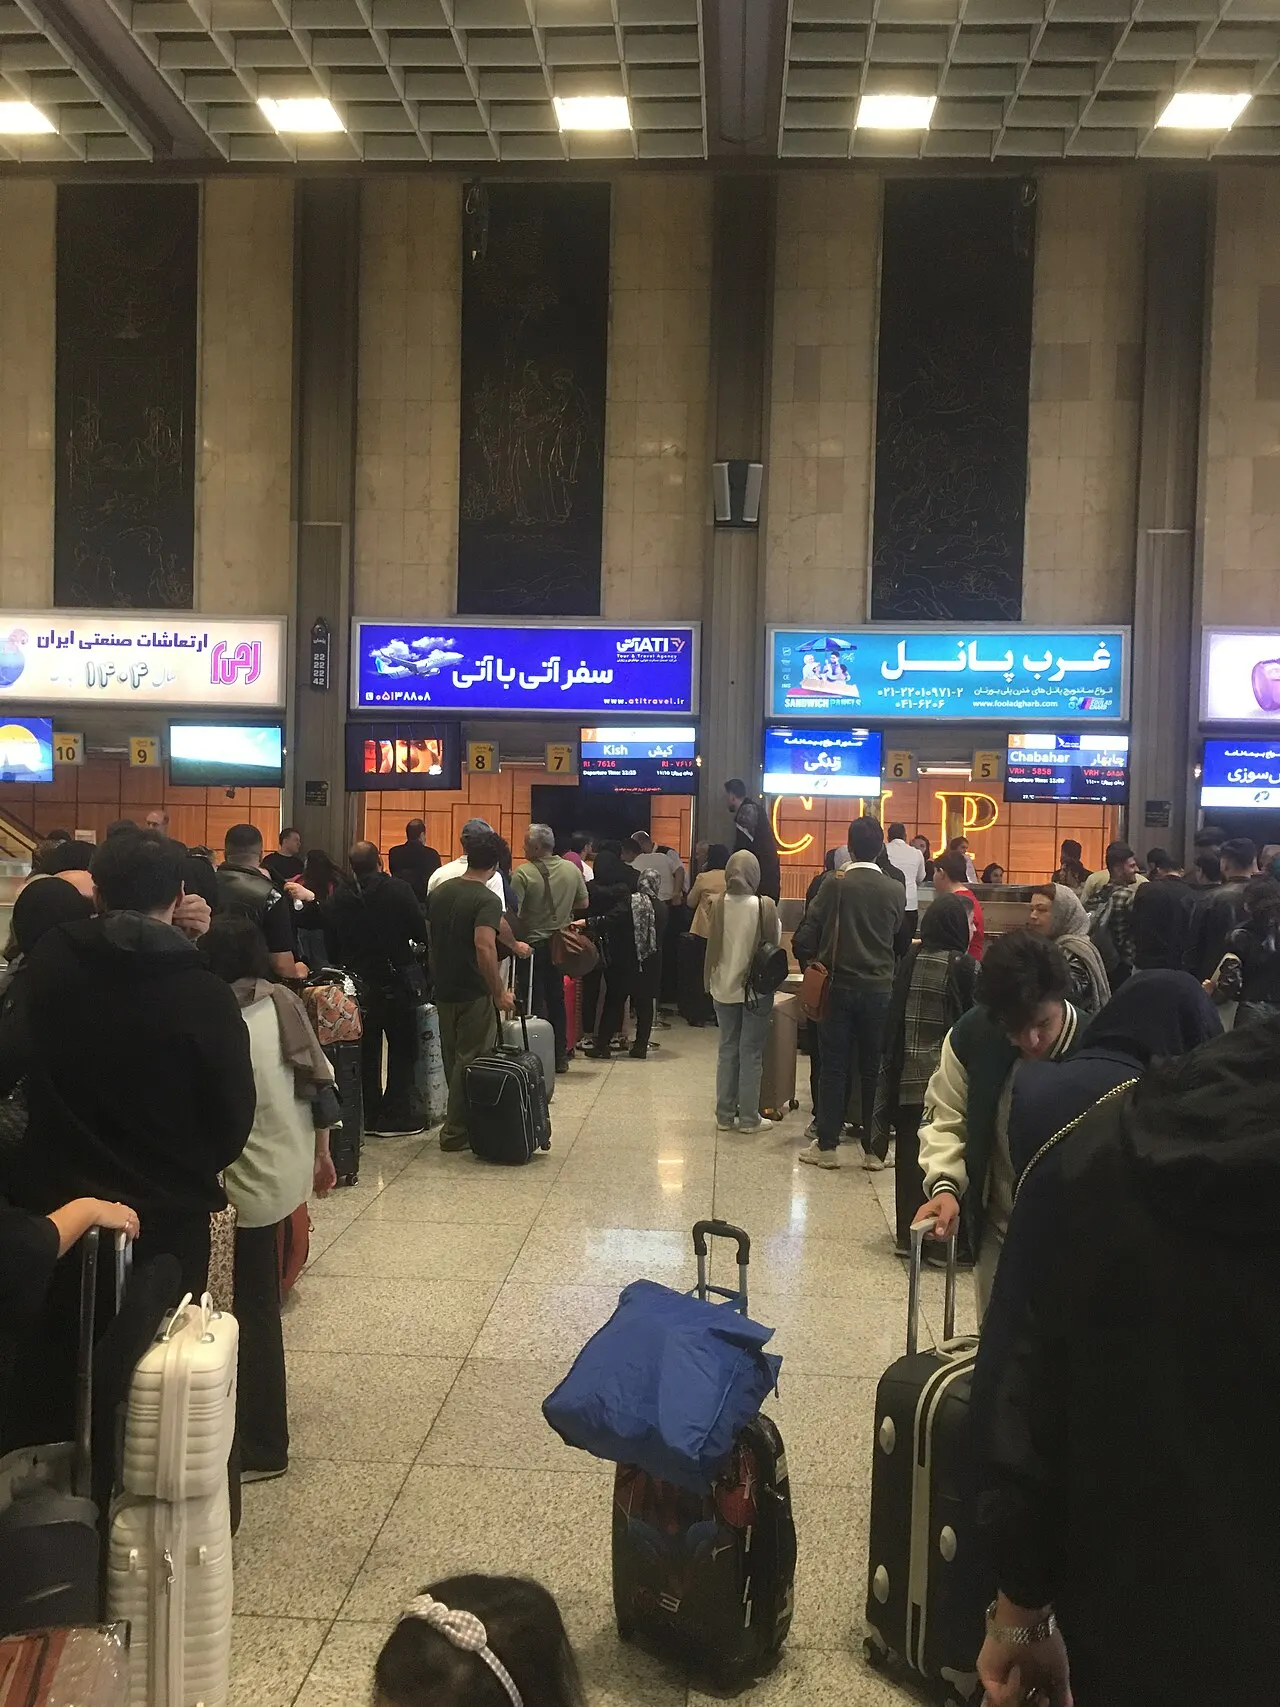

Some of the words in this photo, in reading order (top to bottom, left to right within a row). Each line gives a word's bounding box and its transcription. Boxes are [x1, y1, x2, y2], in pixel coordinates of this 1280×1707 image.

[37, 629, 75, 648] ایران
[79, 633, 132, 649] صنعتی
[137, 631, 208, 652] ارتعاشات
[313, 653, 326, 661] 22
[880, 640, 1015, 683] پانل
[1022, 641, 1111, 682] غرب
[313, 661, 325, 669] 22
[452, 655, 495, 689] آتی
[86, 660, 149, 690] ۱۴۰۴
[313, 669, 325, 677] 22
[496, 658, 517, 690] با
[518, 656, 561, 690] آتی
[560, 660, 614, 691] سفر
[312, 677, 325, 685] 42
[375, 691, 431, 701] ۰۵۱۳۸۸۰۸
[603, 697, 685, 705] www.atitravel.ir
[56, 746, 76, 761] 10
[137, 749, 147, 763] 9
[603, 744, 629, 756] Kish
[648, 744, 674, 758] کیش
[1010, 750, 1070, 763] Chabahar
[475, 755, 486, 770] 8
[553, 756, 564, 771] 7
[597, 760, 616, 768] 7616
[1090, 749, 1125, 767] چابهار
[893, 763, 904, 777] 6
[981, 763, 991, 778] 5
[1031, 767, 1052, 775] 5858
